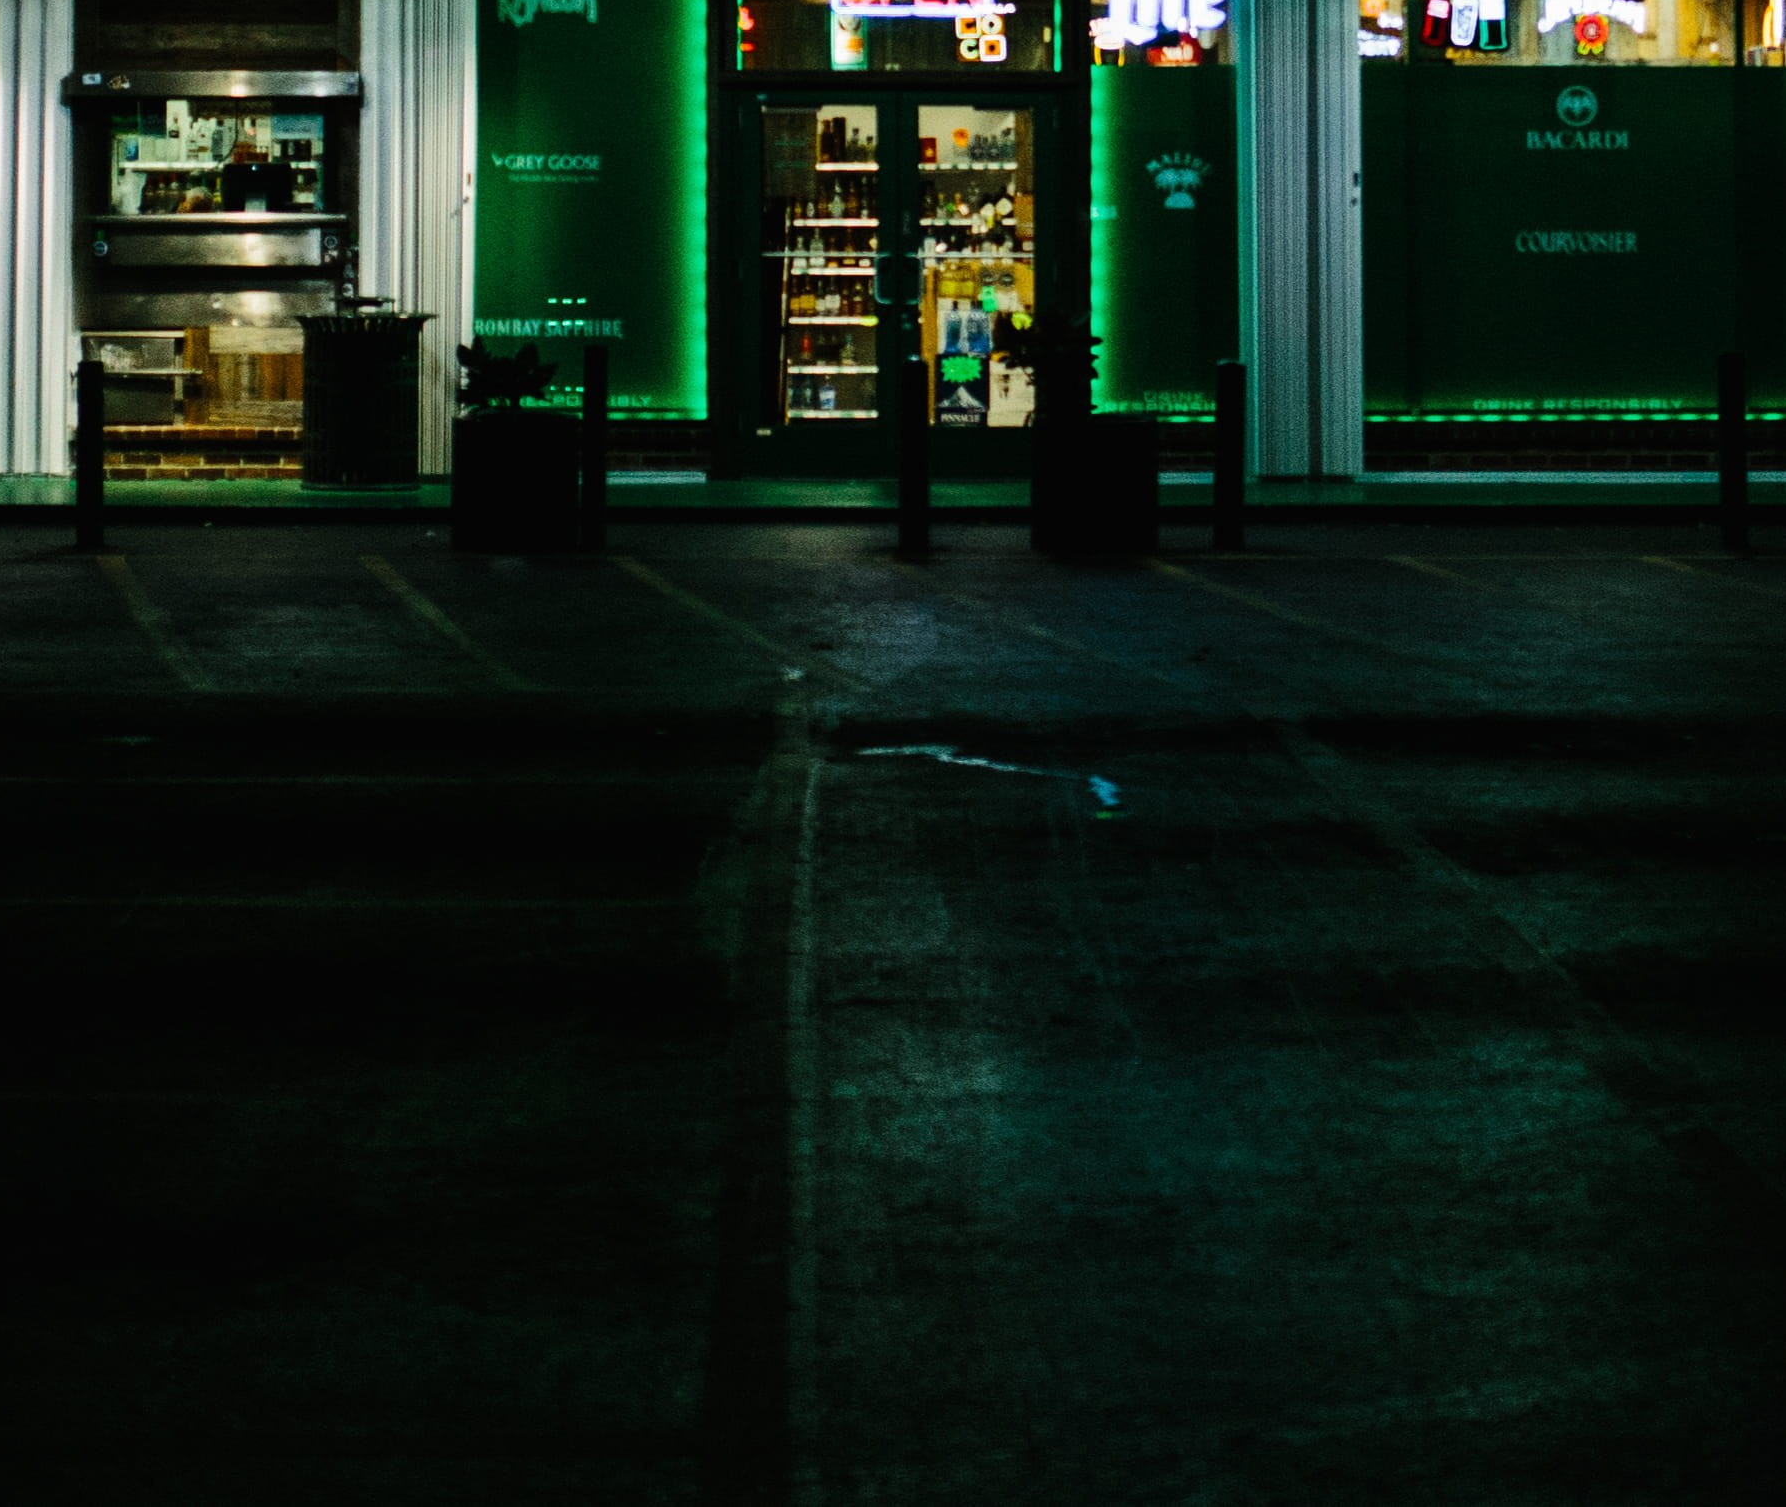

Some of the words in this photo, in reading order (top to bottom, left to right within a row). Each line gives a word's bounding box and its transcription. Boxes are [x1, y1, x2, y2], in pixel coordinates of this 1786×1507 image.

[1526, 129, 1630, 150] BACARDI
[504, 153, 545, 171] GREY
[548, 153, 601, 171] GOOSE
[474, 318, 542, 337] BOMBAY
[544, 319, 624, 339] SAPPHIRE
